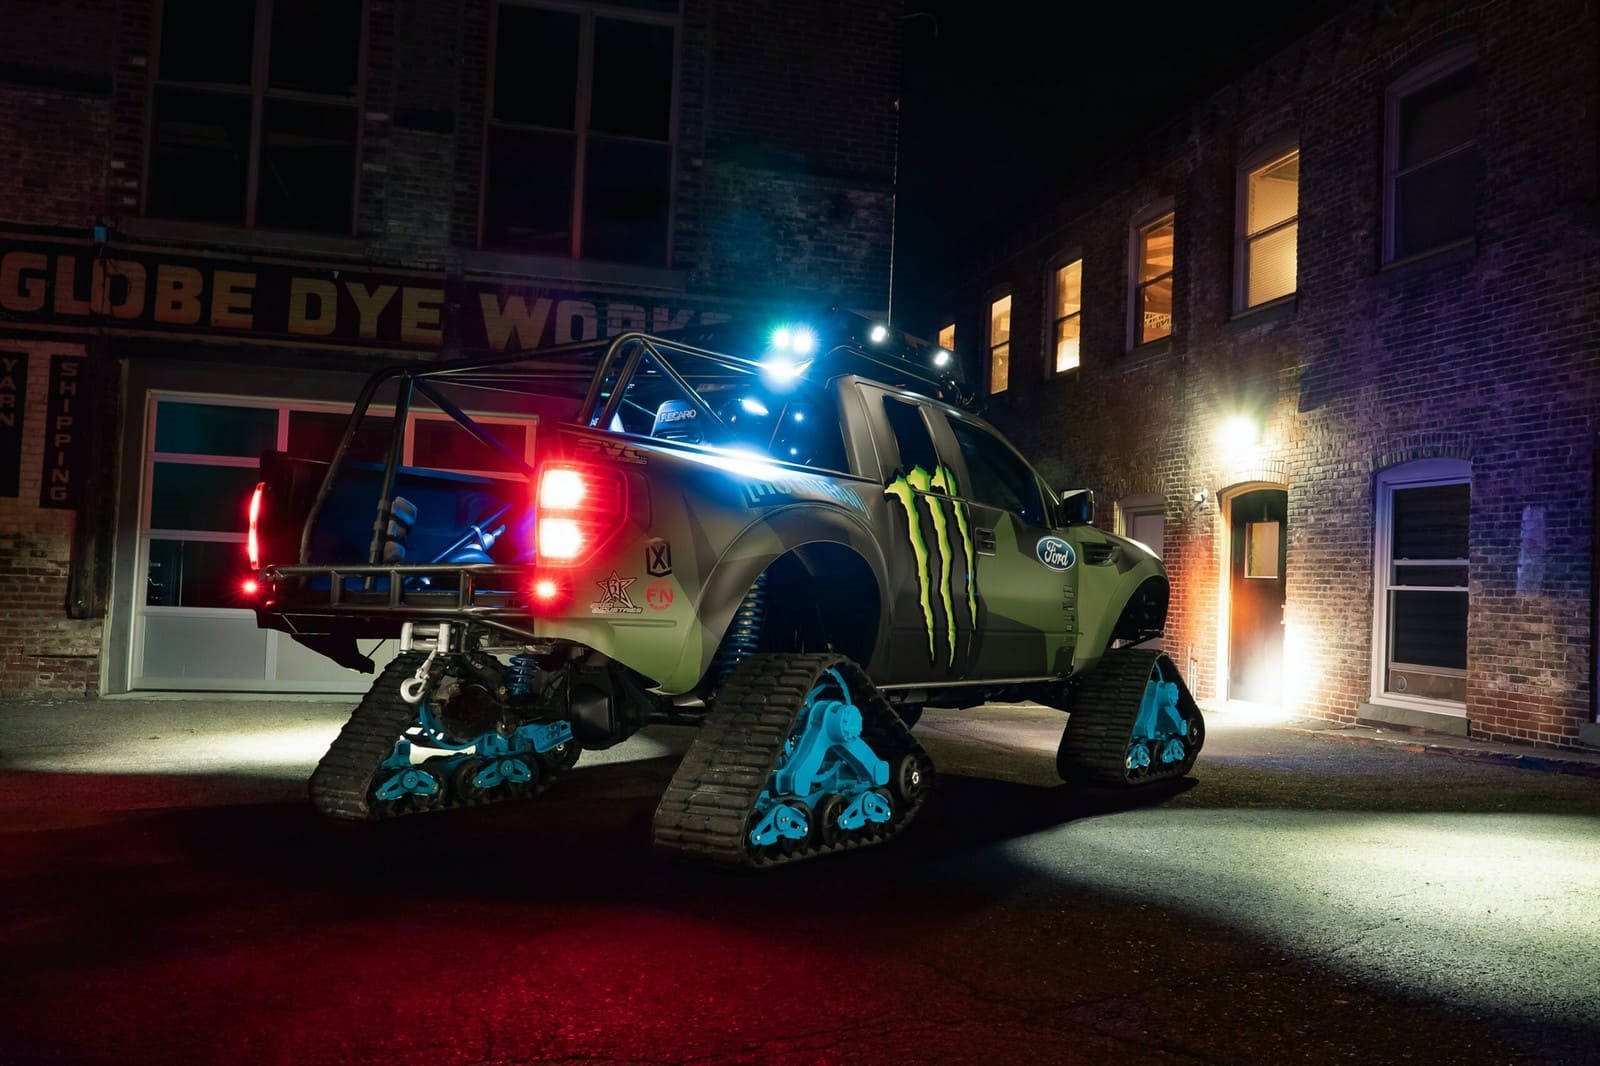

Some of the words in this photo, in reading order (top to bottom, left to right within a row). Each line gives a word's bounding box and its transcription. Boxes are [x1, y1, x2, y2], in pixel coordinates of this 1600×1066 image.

[0, 249, 258, 329] GLOBE
[288, 275, 446, 346] DYE
[479, 292, 733, 351] WORK
[50, 361, 80, 501] SHIPPING
[1044, 540, 1069, 566] Ford
